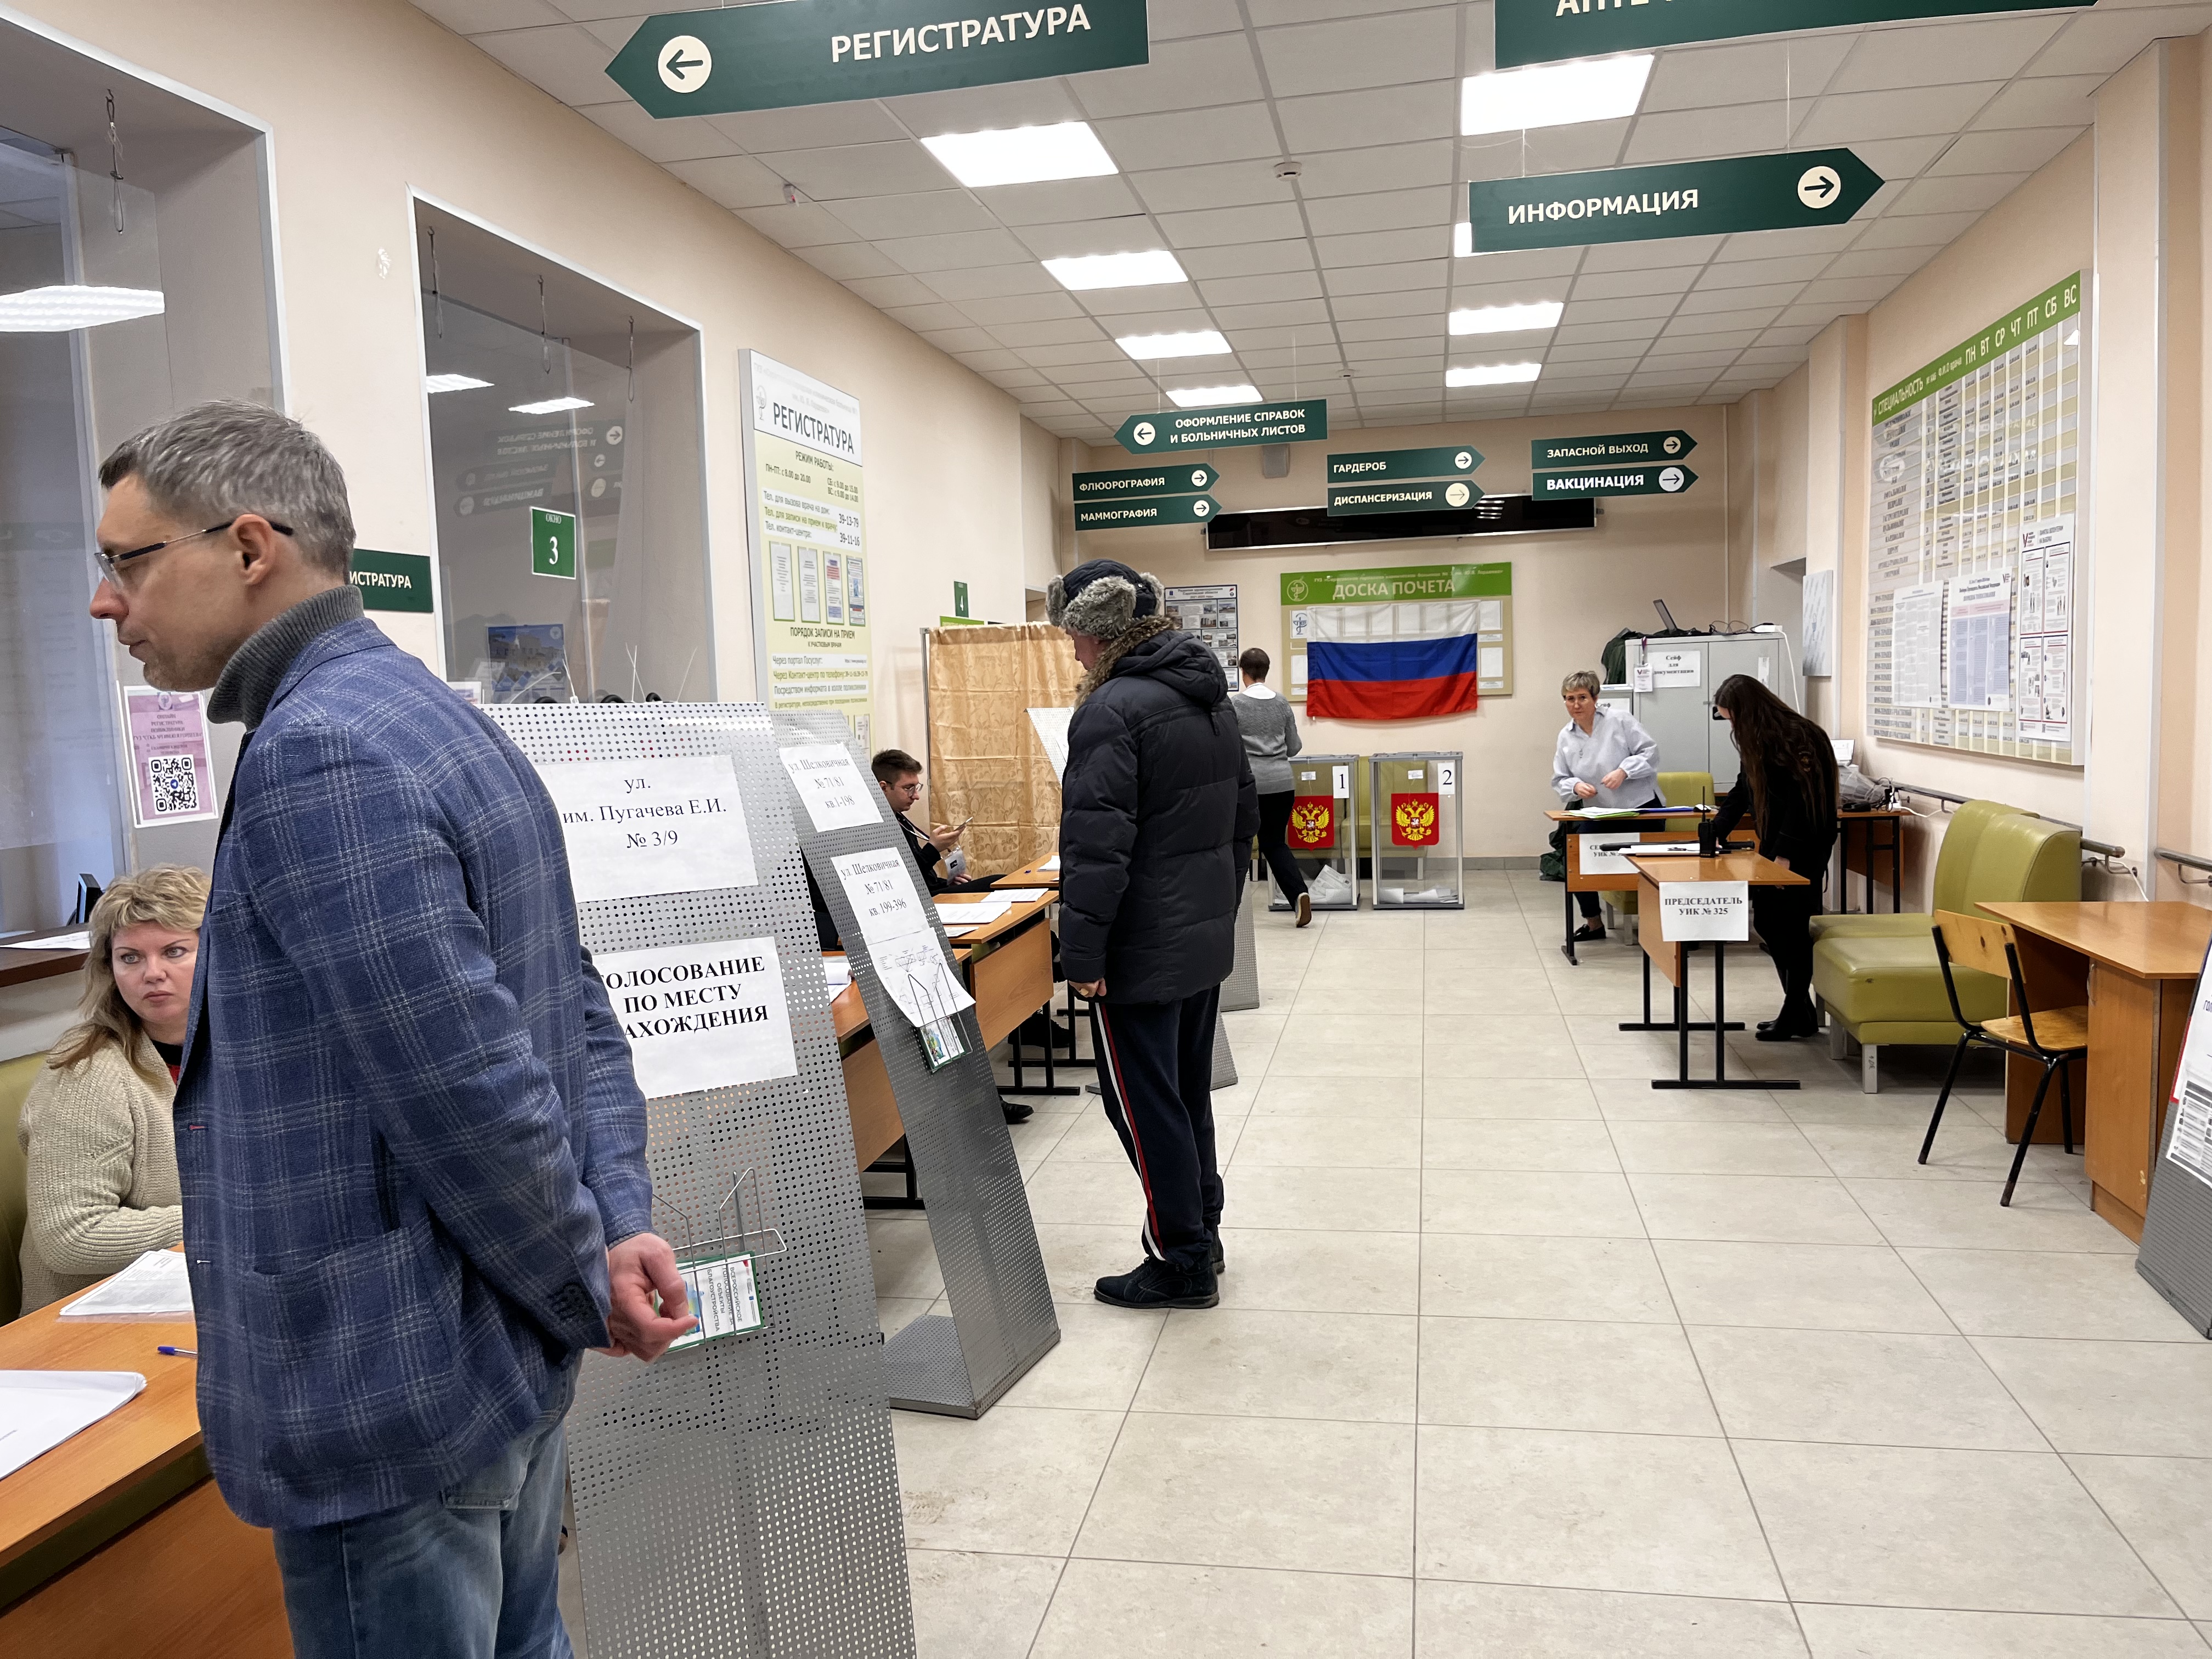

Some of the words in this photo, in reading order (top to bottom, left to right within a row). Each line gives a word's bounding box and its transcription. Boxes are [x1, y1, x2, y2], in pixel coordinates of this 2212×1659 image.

[831, 4, 1091, 63] РЕГИСТРАТУРА
[1508, 189, 1699, 224] ИНФОРМАЦИЯ
[1878, 377, 1923, 415] СПЕЦИАЛЬНОСТЬ
[1966, 345, 1976, 365] ПН
[1981, 336, 1990, 356] ВТ
[1995, 327, 2005, 347] СР
[2011, 317, 2021, 337] ЧТ
[2027, 307, 2038, 329] ПТ
[2046, 296, 2057, 318] СБ
[2064, 284, 2076, 308] ВС
[1175, 413, 1251, 428] ОФОРМЛЕНИЕ
[1254, 409, 1305, 422] СПРАВОК
[774, 402, 854, 454] РЕГИСТРАТУРА
[1170, 435, 1178, 443] И
[1181, 428, 1258, 443] БОЛЬНИЧНЫХ
[1261, 425, 1305, 436] ЛИСТОВ
[1547, 444, 1605, 458] ЗАПАСНОЙ
[1609, 443, 1648, 455] ВЫХОД
[795, 451, 813, 465] РЕЖИМ
[814, 456, 834, 472] РАБОТЫ:
[1334, 461, 1386, 473] ГАРДЕРОБ
[766, 464, 781, 475] ПН-ПТ:
[785, 469, 793, 478] 8.00
[800, 473, 811, 483] 20.00
[1079, 477, 1165, 491] ФЛЮОРОГРАФИЯ
[1547, 475, 1644, 490] ВАКЦИНАЦИЯ
[764, 490, 774, 501] Тел.
[1334, 491, 1432, 506] ДИСПАНСЕРИЗАЦИЯ
[546, 514, 562, 524] ОКНО
[765, 506, 775, 517] Тел.
[1081, 509, 1157, 521] МАММОГРАФИЯ
[765, 521, 776, 531] Тел.
[839, 514, 859, 528] 39-13-79
[840, 532, 860, 546] 39-11-16
[549, 536, 558, 565] 3
[349, 571, 412, 589] ИСТРАТУРА
[1333, 583, 1389, 600] ДОСКА
[1392, 579, 1455, 595] ПОЧЕТА
[790, 627, 814, 639] ПОРЯДОК
[815, 628, 833, 638] ЗАПИСИ
[834, 630, 840, 638] НА
[841, 629, 855, 639] ПРИЕМ
[772, 656, 787, 666] Через
[774, 671, 787, 681] Через
[788, 763, 801, 774] ул.
[800, 759, 850, 769] Шелковичная
[814, 778, 826, 788] №
[824, 777, 844, 787] 71/81
[1340, 774, 1345, 789] 1
[1443, 770, 1453, 785] 2
[624, 778, 651, 793] ул.
[562, 812, 594, 823] им.
[598, 805, 685, 823] Пугачева
[688, 798, 726, 814] Е.И.
[626, 833, 647, 848] №
[651, 830, 678, 846] 3/9
[840, 868, 853, 880] ул.
[852, 860, 900, 874] Шелковичная
[865, 883, 874, 894] №
[874, 880, 893, 892] 71/81
[869, 908, 880, 916] кв.
[880, 898, 906, 913] 199-396
[1665, 897, 1742, 906] ПРЕДСЕДАТЕЛЬ
[601, 956, 765, 989] ОЛОСОВАНИЕ
[624, 995, 657, 1013] ПО
[664, 984, 741, 1008] МЕСТУ
[624, 1005, 769, 1039] АХОЖДЕНИЯ
[707, 1269, 720, 1332] БЛАГОУСТРОЙСТВА
[717, 1283, 725, 1314] ОБЪЕКТЫ
[730, 1267, 742, 1323] ВСЕРОССИЙСКОЕ
